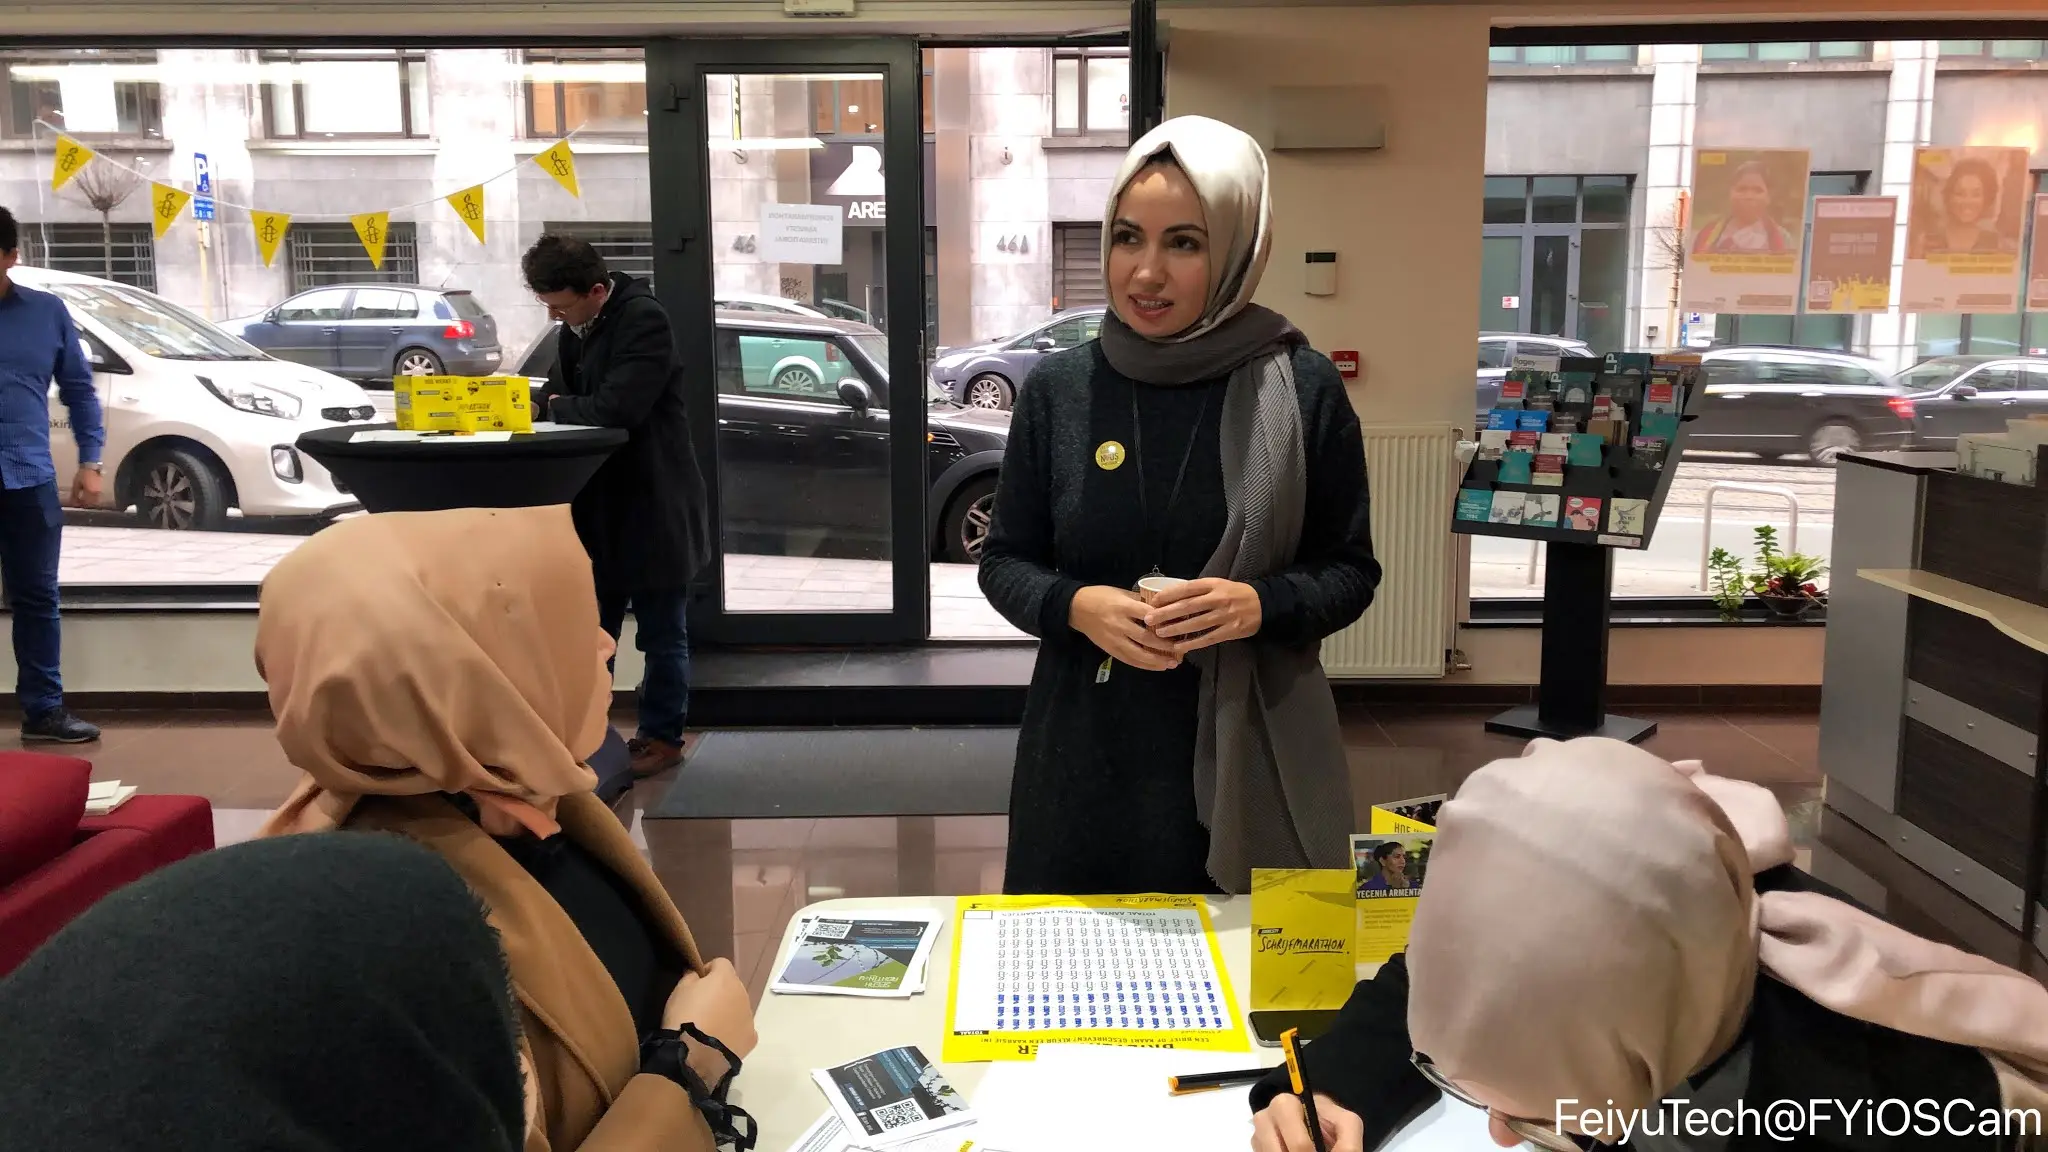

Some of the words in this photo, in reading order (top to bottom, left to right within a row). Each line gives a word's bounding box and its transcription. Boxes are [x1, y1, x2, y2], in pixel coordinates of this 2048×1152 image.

[194, 157, 208, 186] P
[847, 201, 887, 219] ARE
[1604, 352, 1618, 374] LP
[1548, 372, 1562, 393] LP
[1357, 889, 1387, 899] YECENIA
